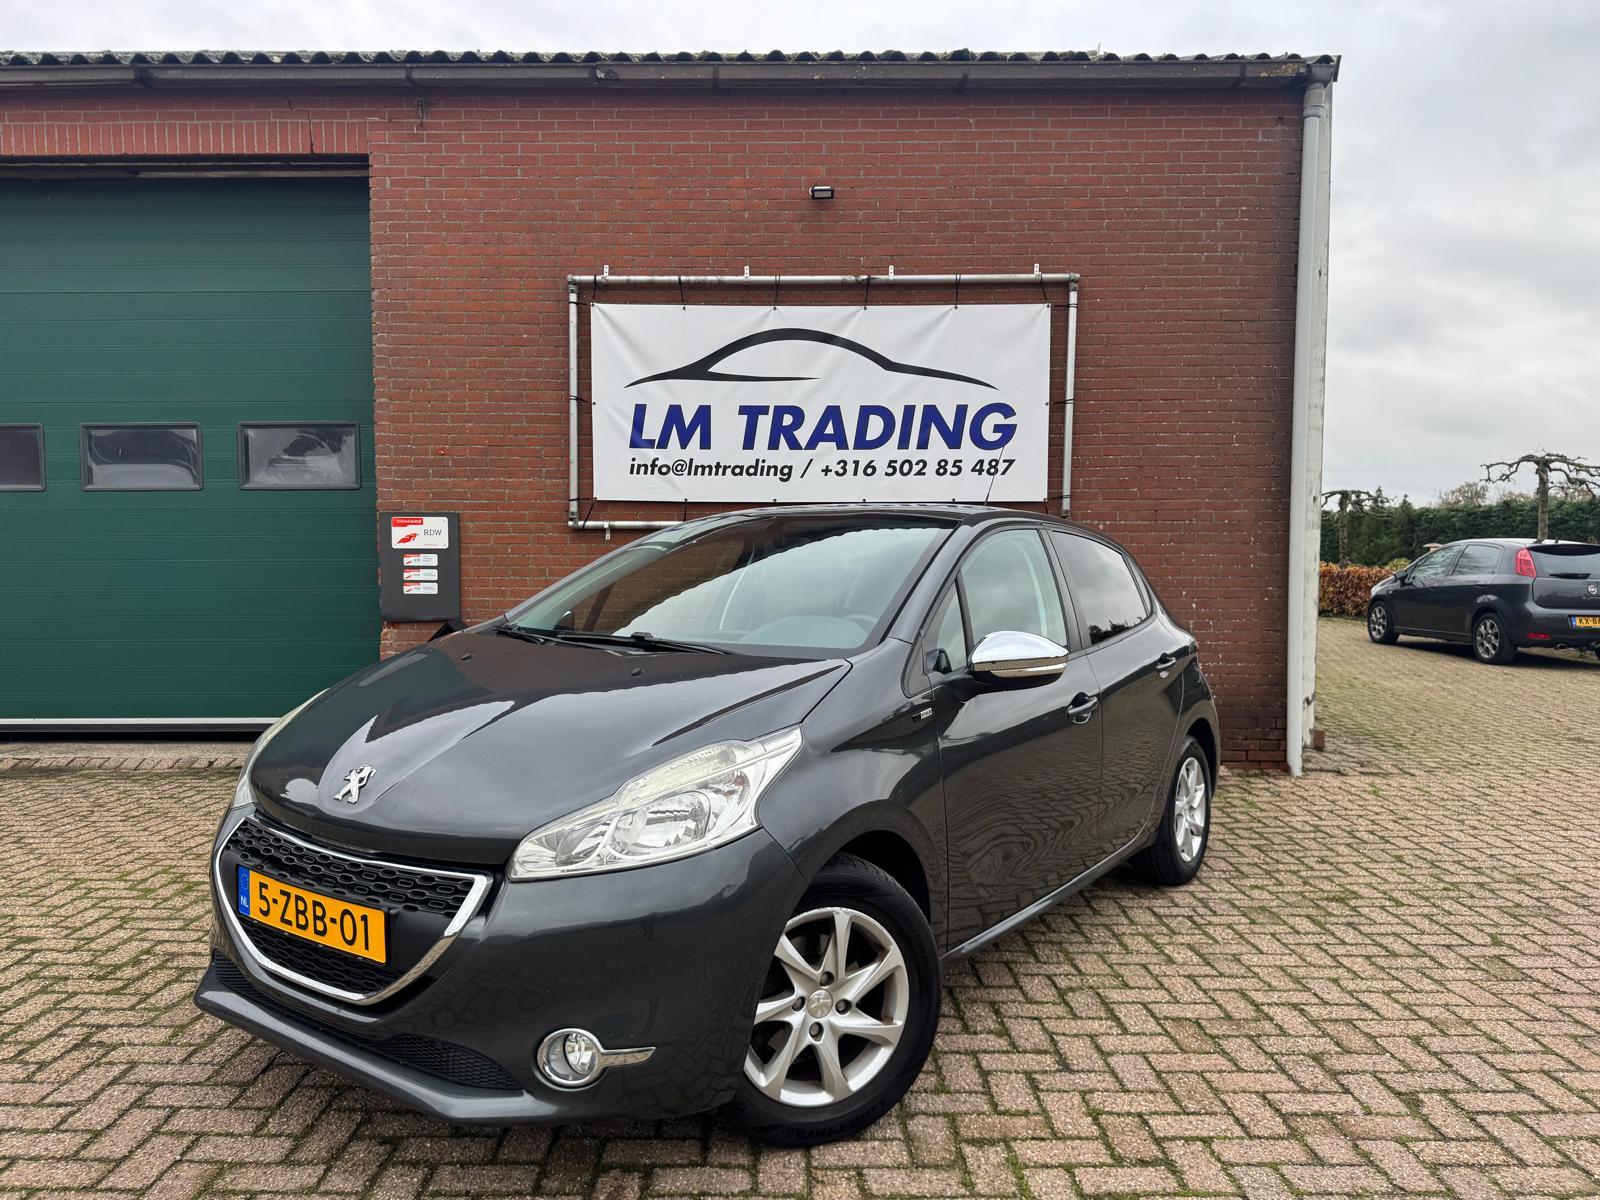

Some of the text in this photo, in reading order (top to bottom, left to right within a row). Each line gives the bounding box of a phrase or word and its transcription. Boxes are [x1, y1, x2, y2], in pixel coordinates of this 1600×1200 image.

[629, 402, 1018, 451] LM TRADING
[629, 457, 1016, 483] info@lmtrading / +316 502 85 487
[258, 881, 370, 951] 5-ZBB-01
